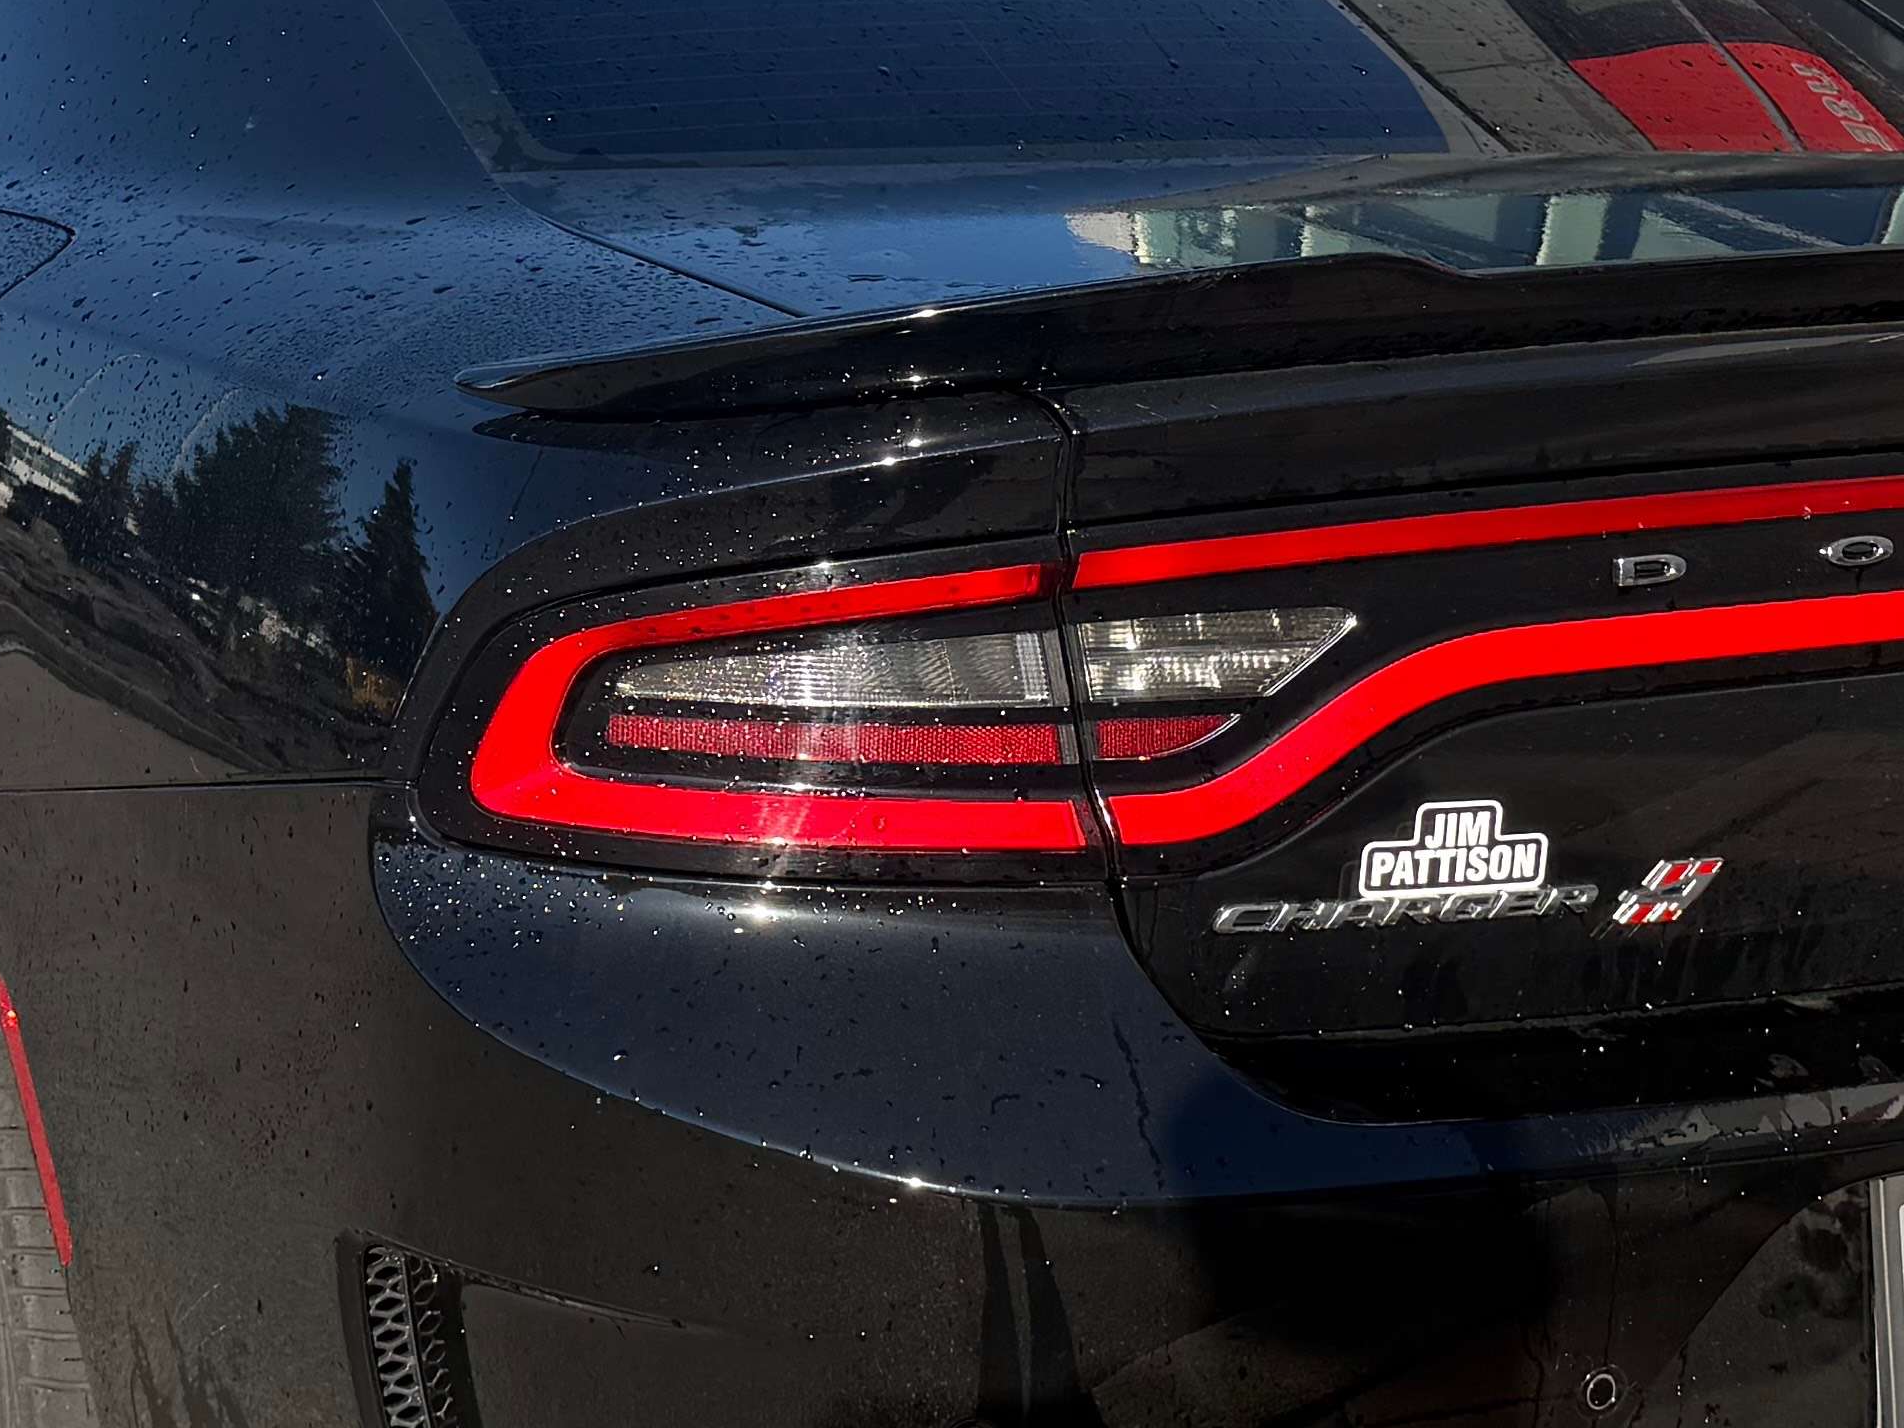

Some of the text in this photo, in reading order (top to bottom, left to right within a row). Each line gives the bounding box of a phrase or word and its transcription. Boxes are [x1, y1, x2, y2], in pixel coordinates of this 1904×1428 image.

[1425, 810, 1491, 850] JIM
[1370, 843, 1537, 888] PATTISON
[1212, 883, 1599, 934] CHARGER
